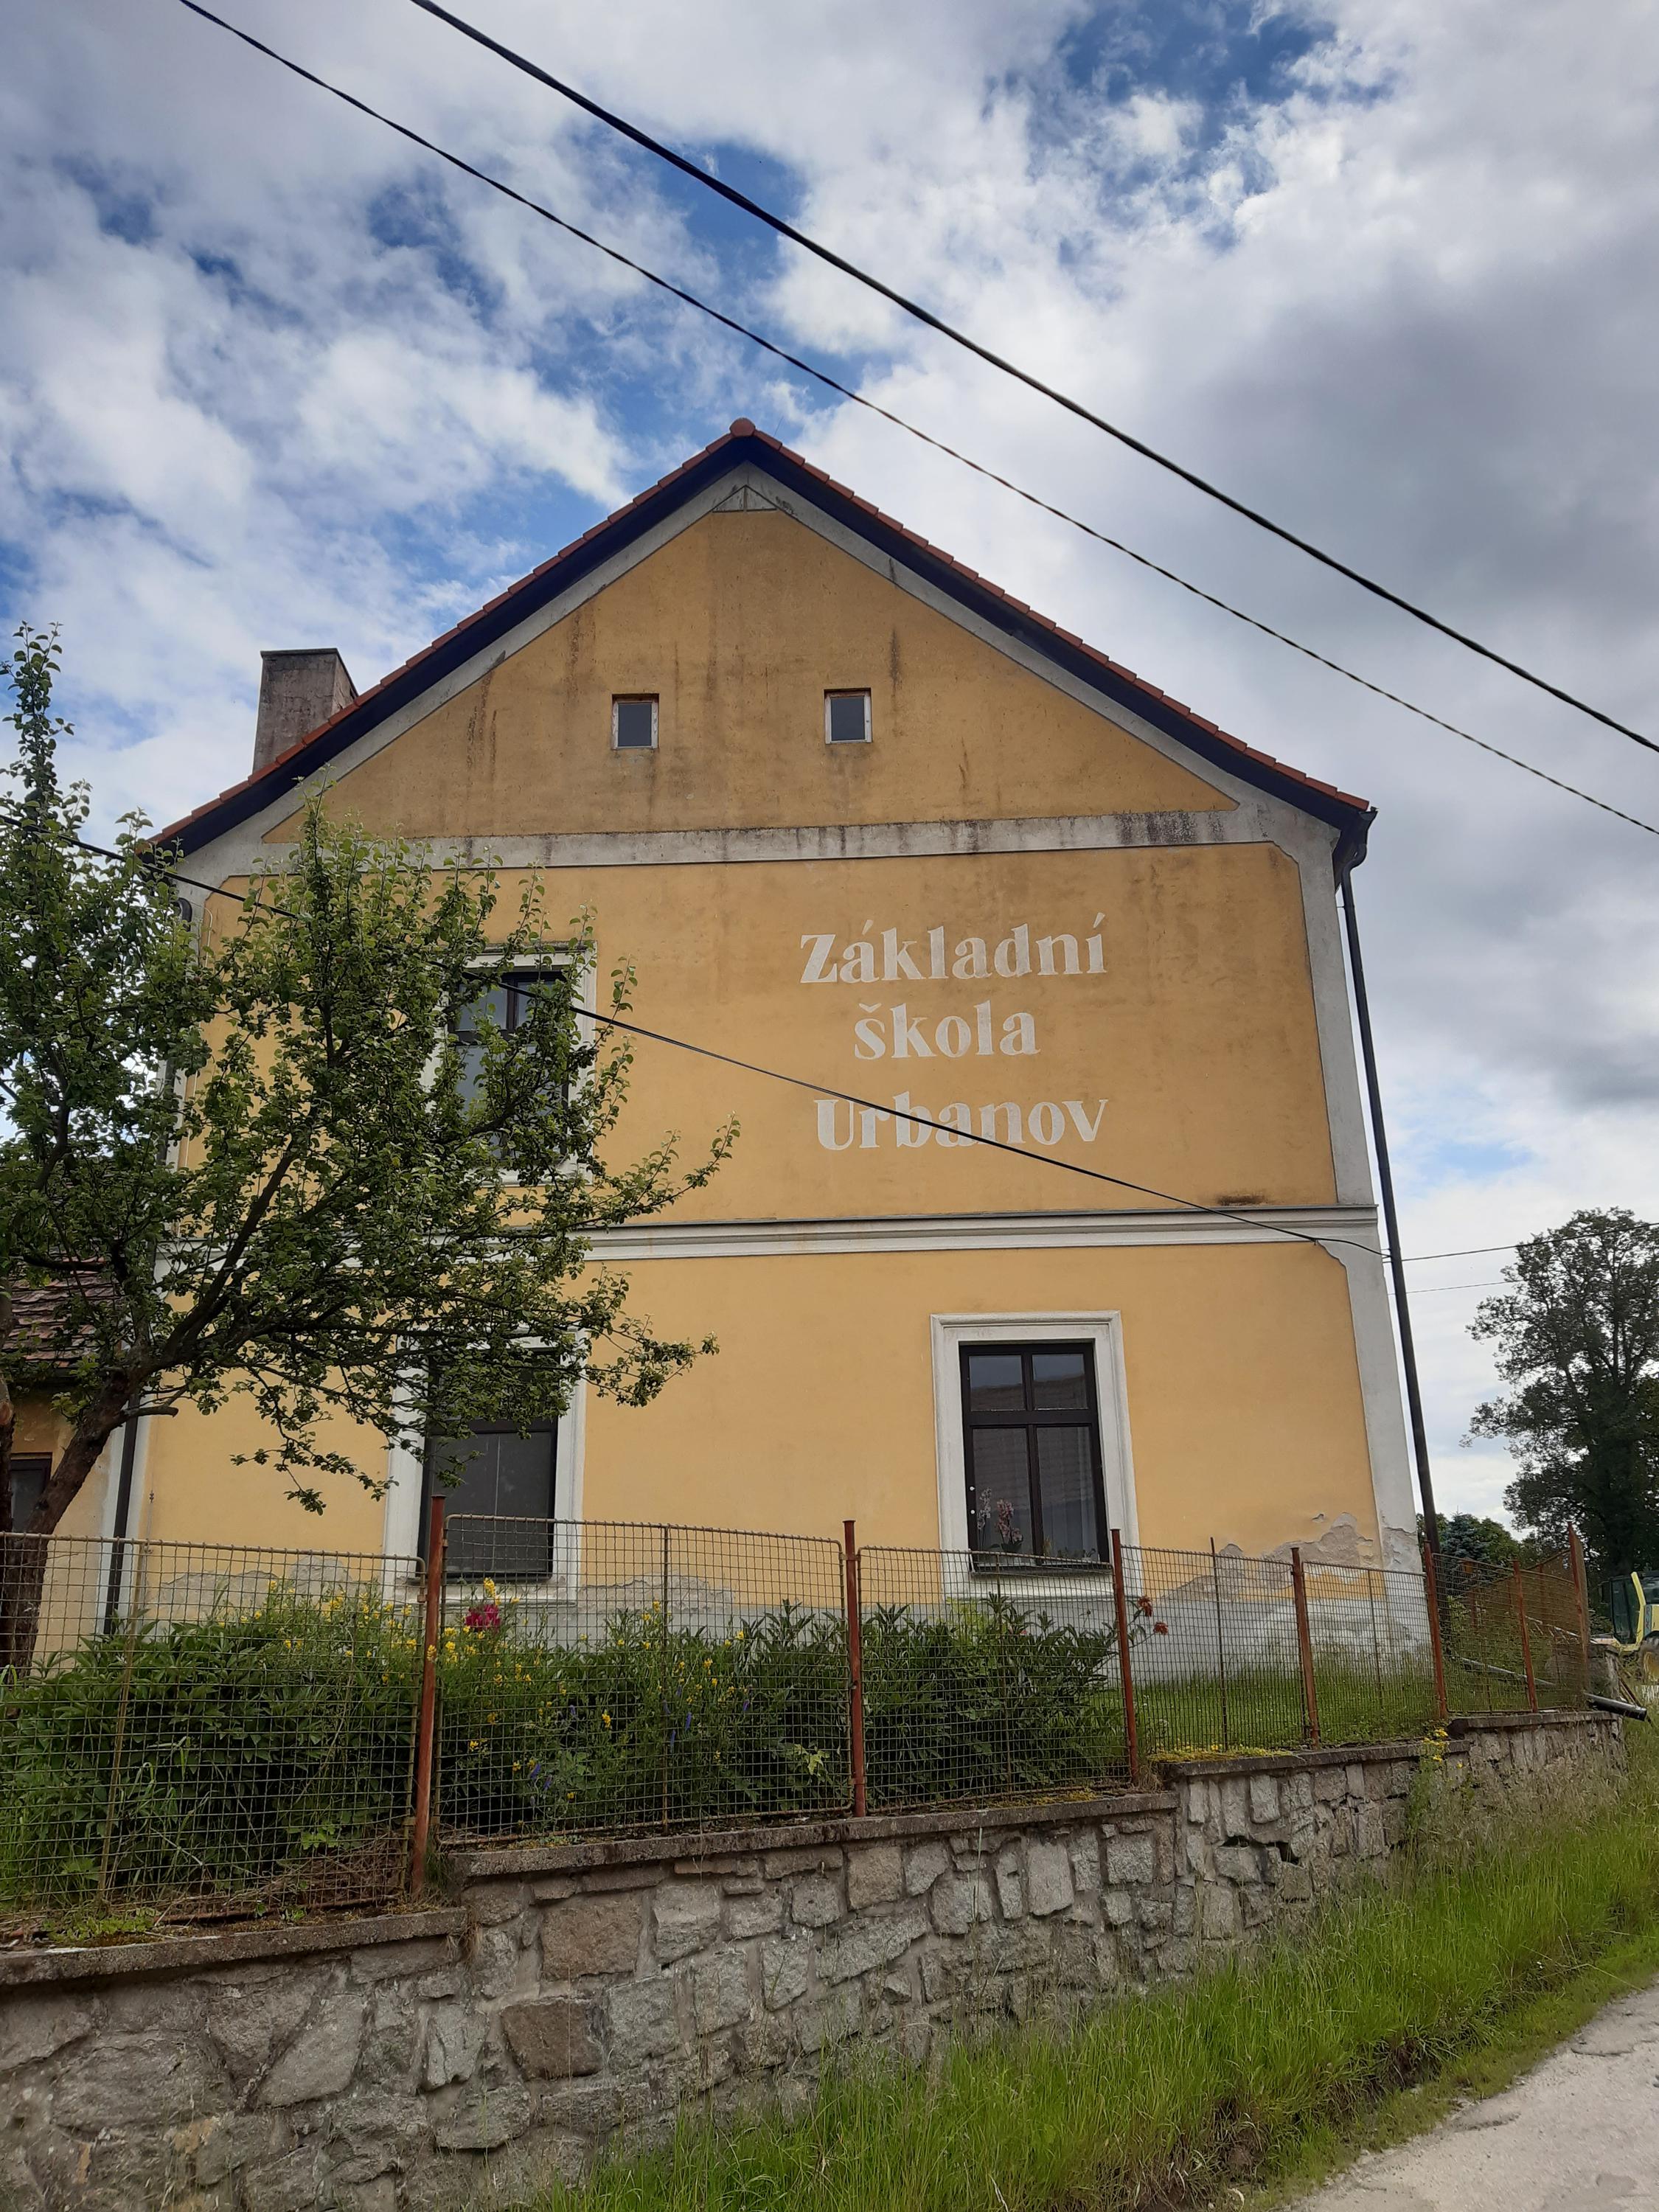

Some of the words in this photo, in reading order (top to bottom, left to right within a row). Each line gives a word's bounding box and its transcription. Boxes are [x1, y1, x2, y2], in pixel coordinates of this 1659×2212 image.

[800, 912, 1107, 984] Základní
[854, 1000, 1040, 1060] škola
[814, 1091, 1108, 1151] Urbanov
